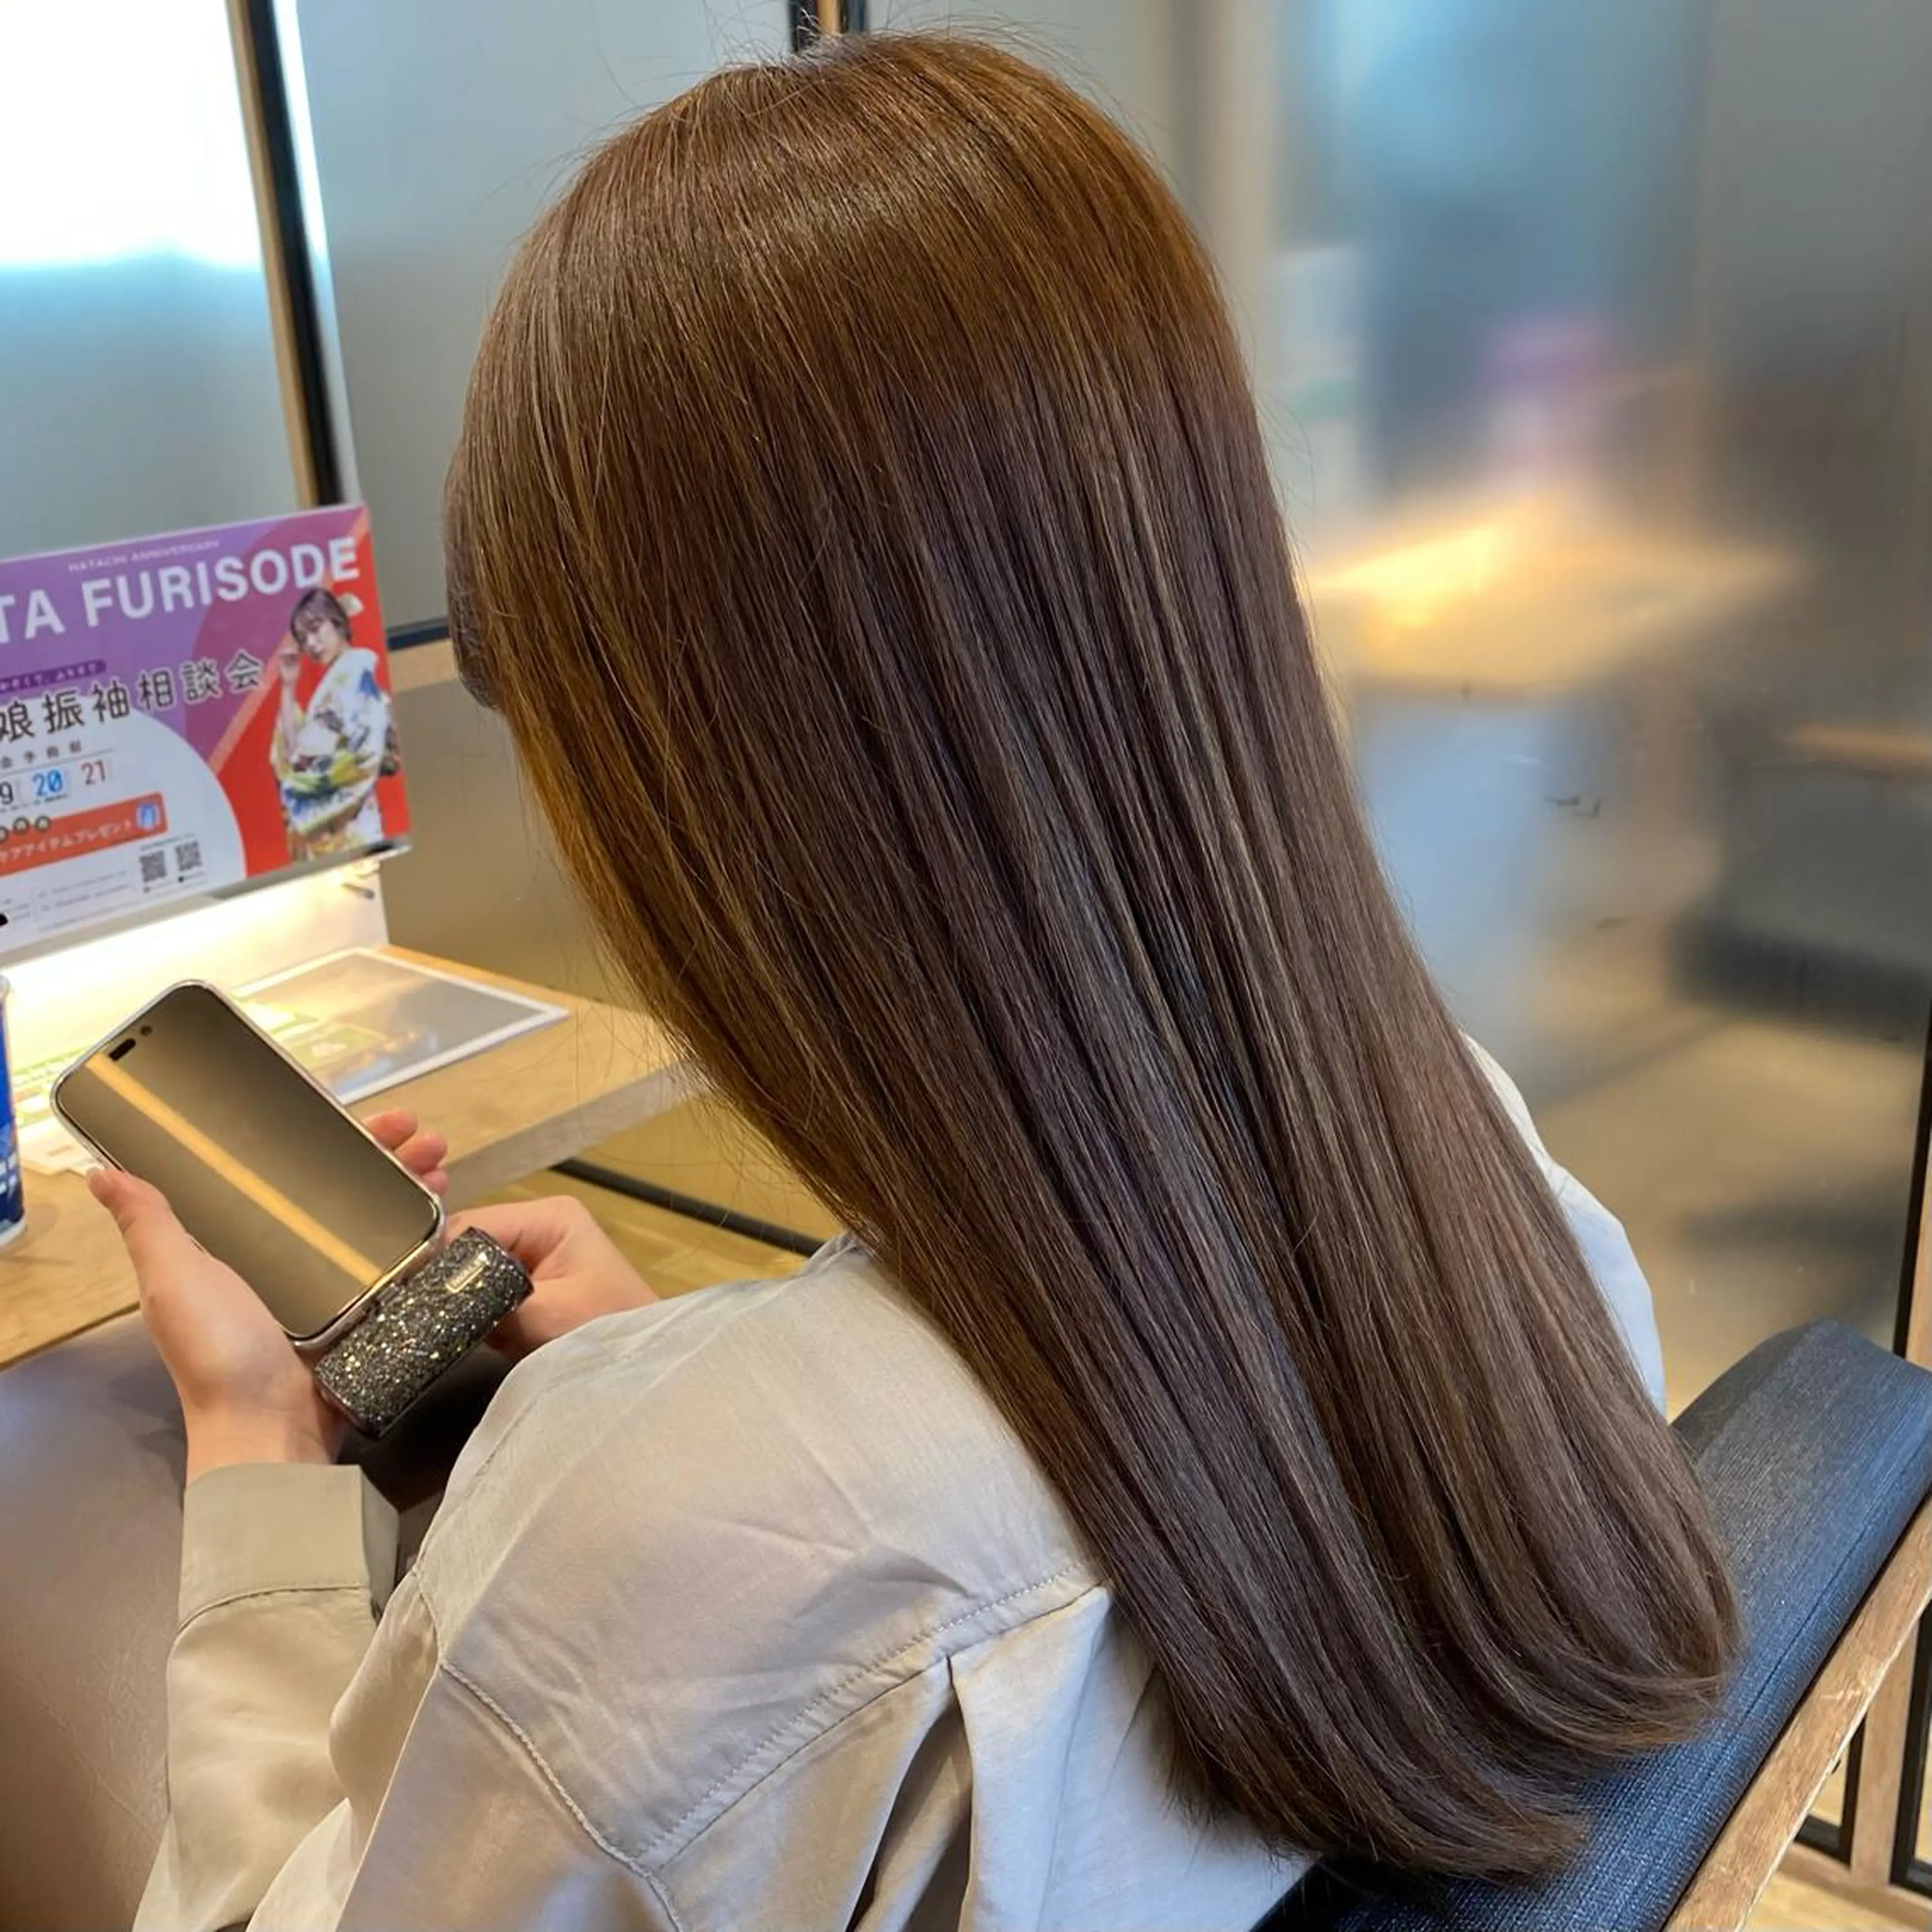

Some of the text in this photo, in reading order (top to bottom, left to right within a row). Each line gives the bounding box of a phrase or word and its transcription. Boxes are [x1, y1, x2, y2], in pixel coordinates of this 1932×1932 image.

[81, 536, 360, 627] FURISODE
[32, 769, 63, 796] 20
[82, 759, 106, 785] 21
